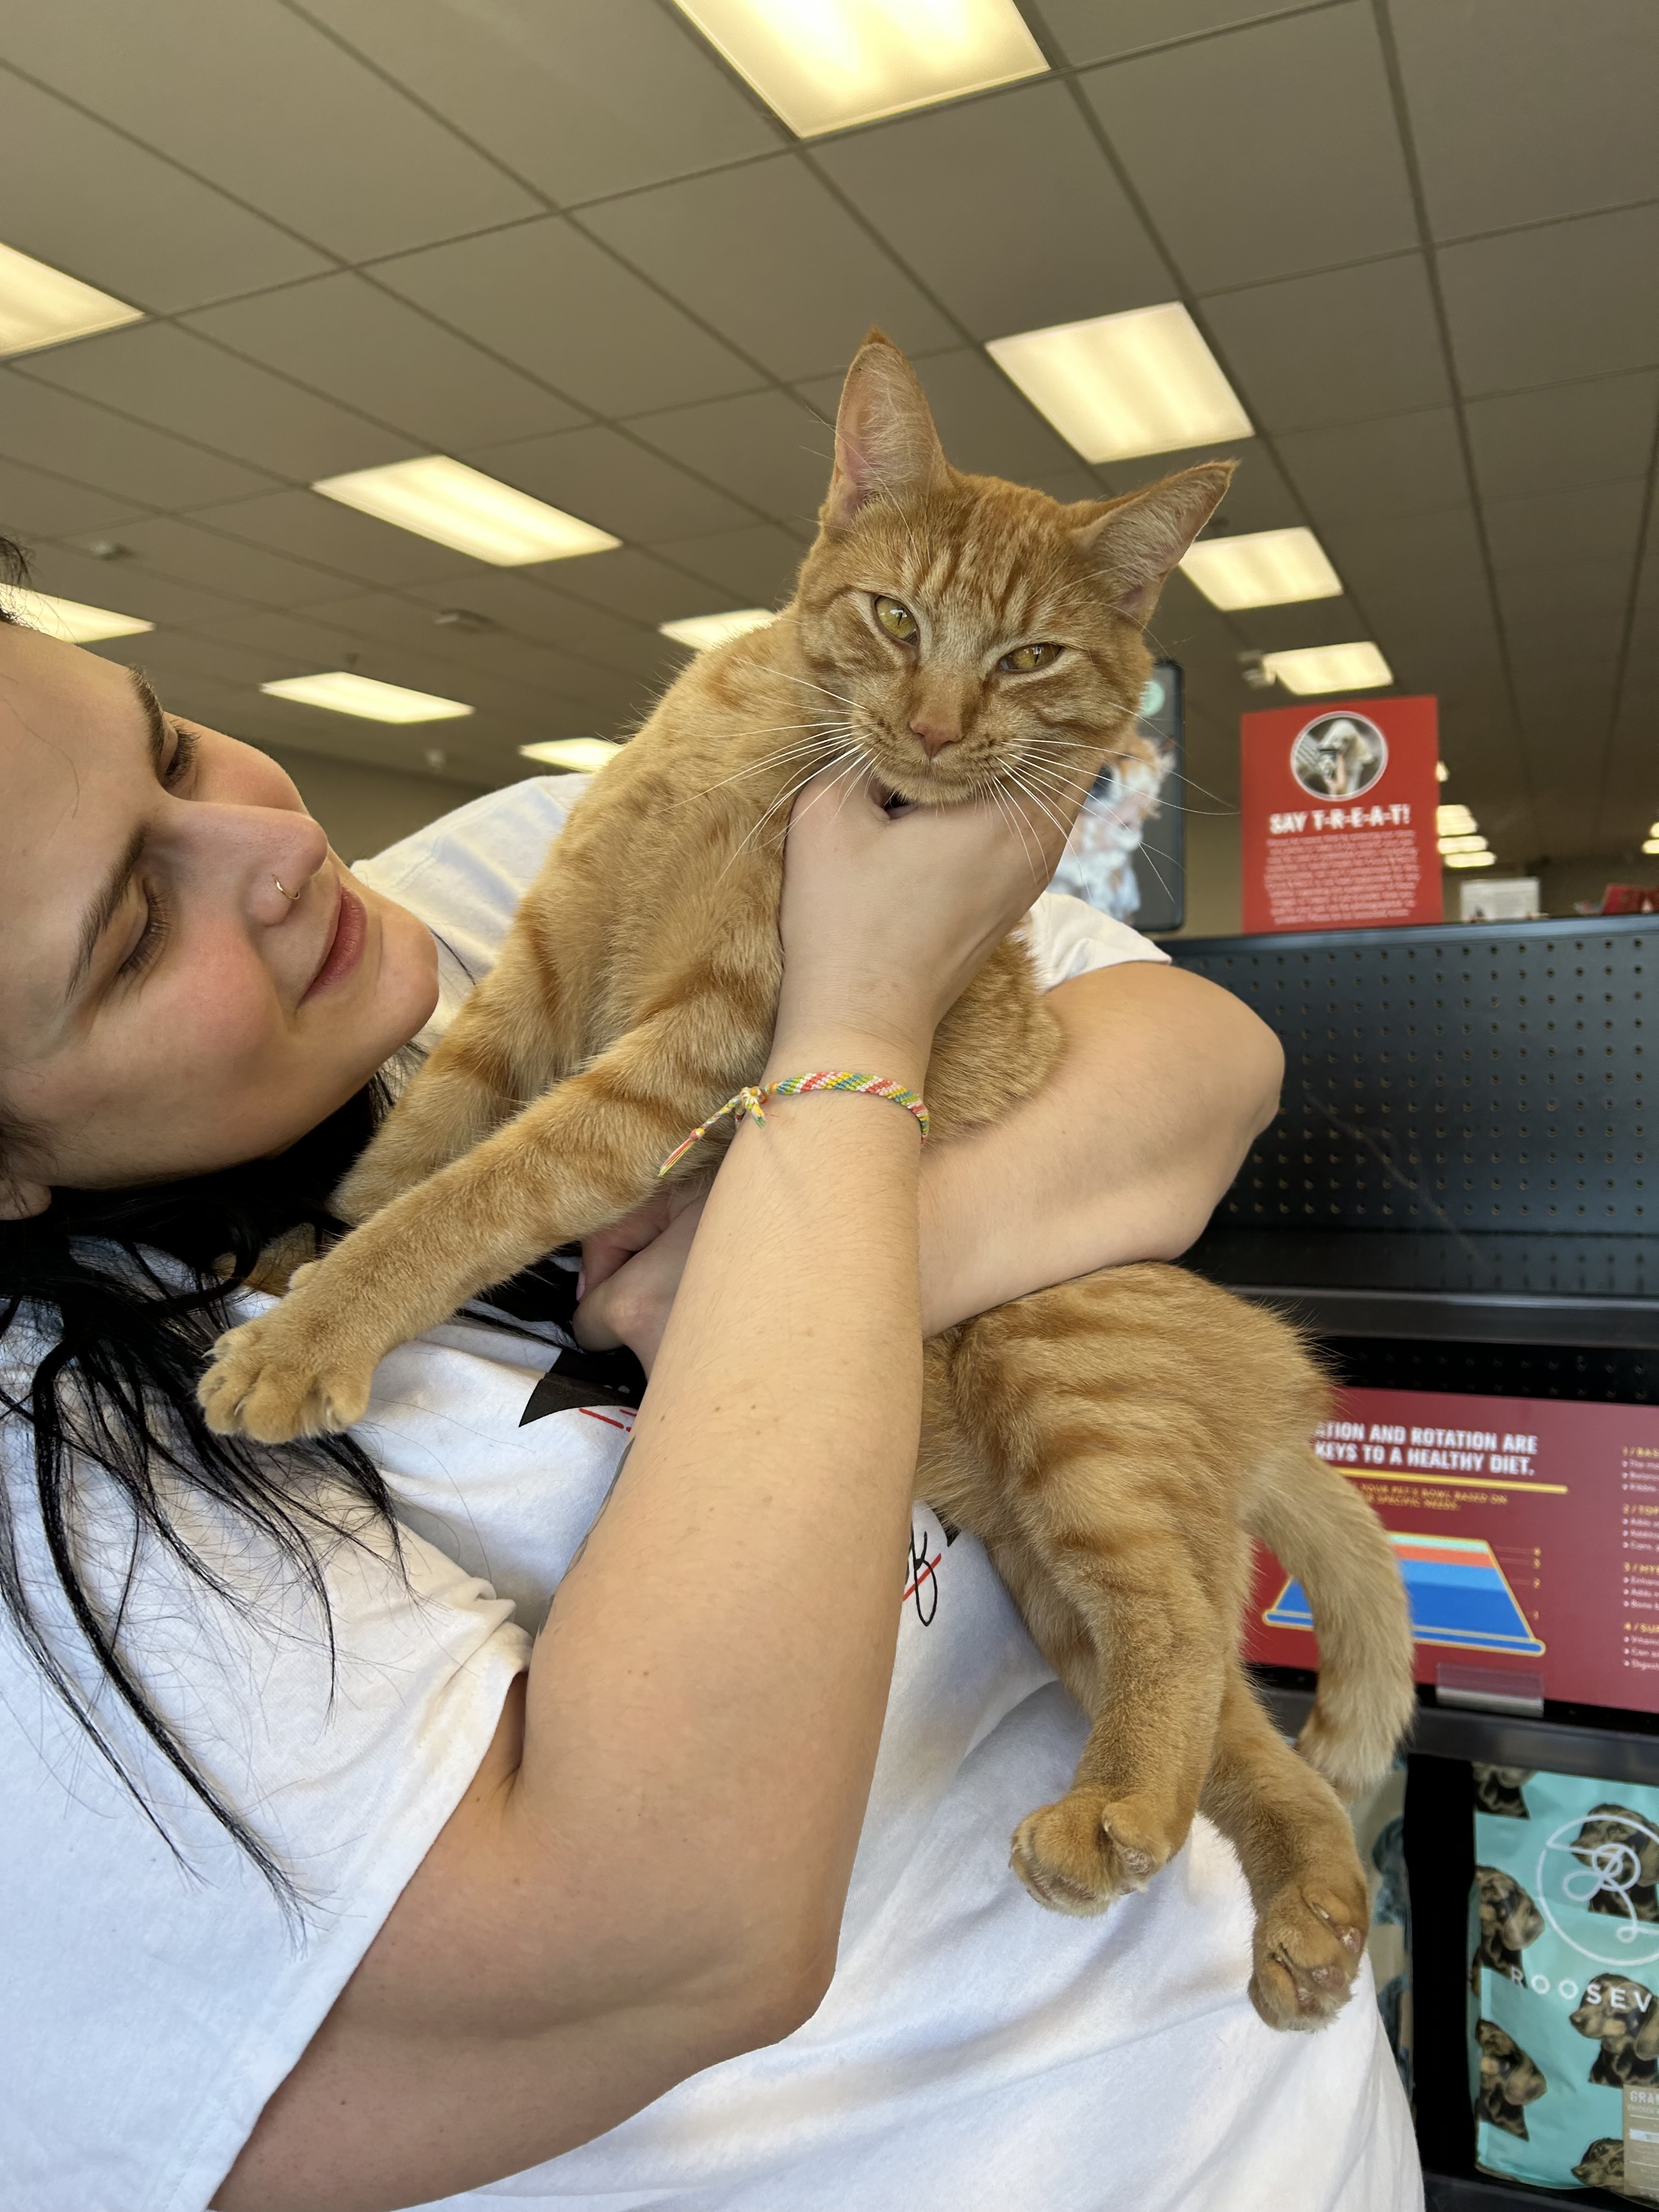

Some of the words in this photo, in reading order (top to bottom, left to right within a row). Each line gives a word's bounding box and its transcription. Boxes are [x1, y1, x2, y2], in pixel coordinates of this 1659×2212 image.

[1269, 811, 1308, 834] SAY
[1311, 803, 1411, 831] T-R-E-A-T!
[1369, 1424, 1407, 1445] AND
[1411, 1426, 1498, 1452] ROTATION
[1503, 1433, 1538, 1455] ARE
[1315, 1441, 1358, 1462] KEYS
[1362, 1443, 1386, 1464] TO
[1390, 1446, 1403, 1465] A
[1407, 1447, 1485, 1472] HEALTHY
[1489, 1454, 1535, 1477] DIET.
[1454, 1489, 1488, 1504] BASED
[1510, 1966, 1653, 2014] ROOSEV
